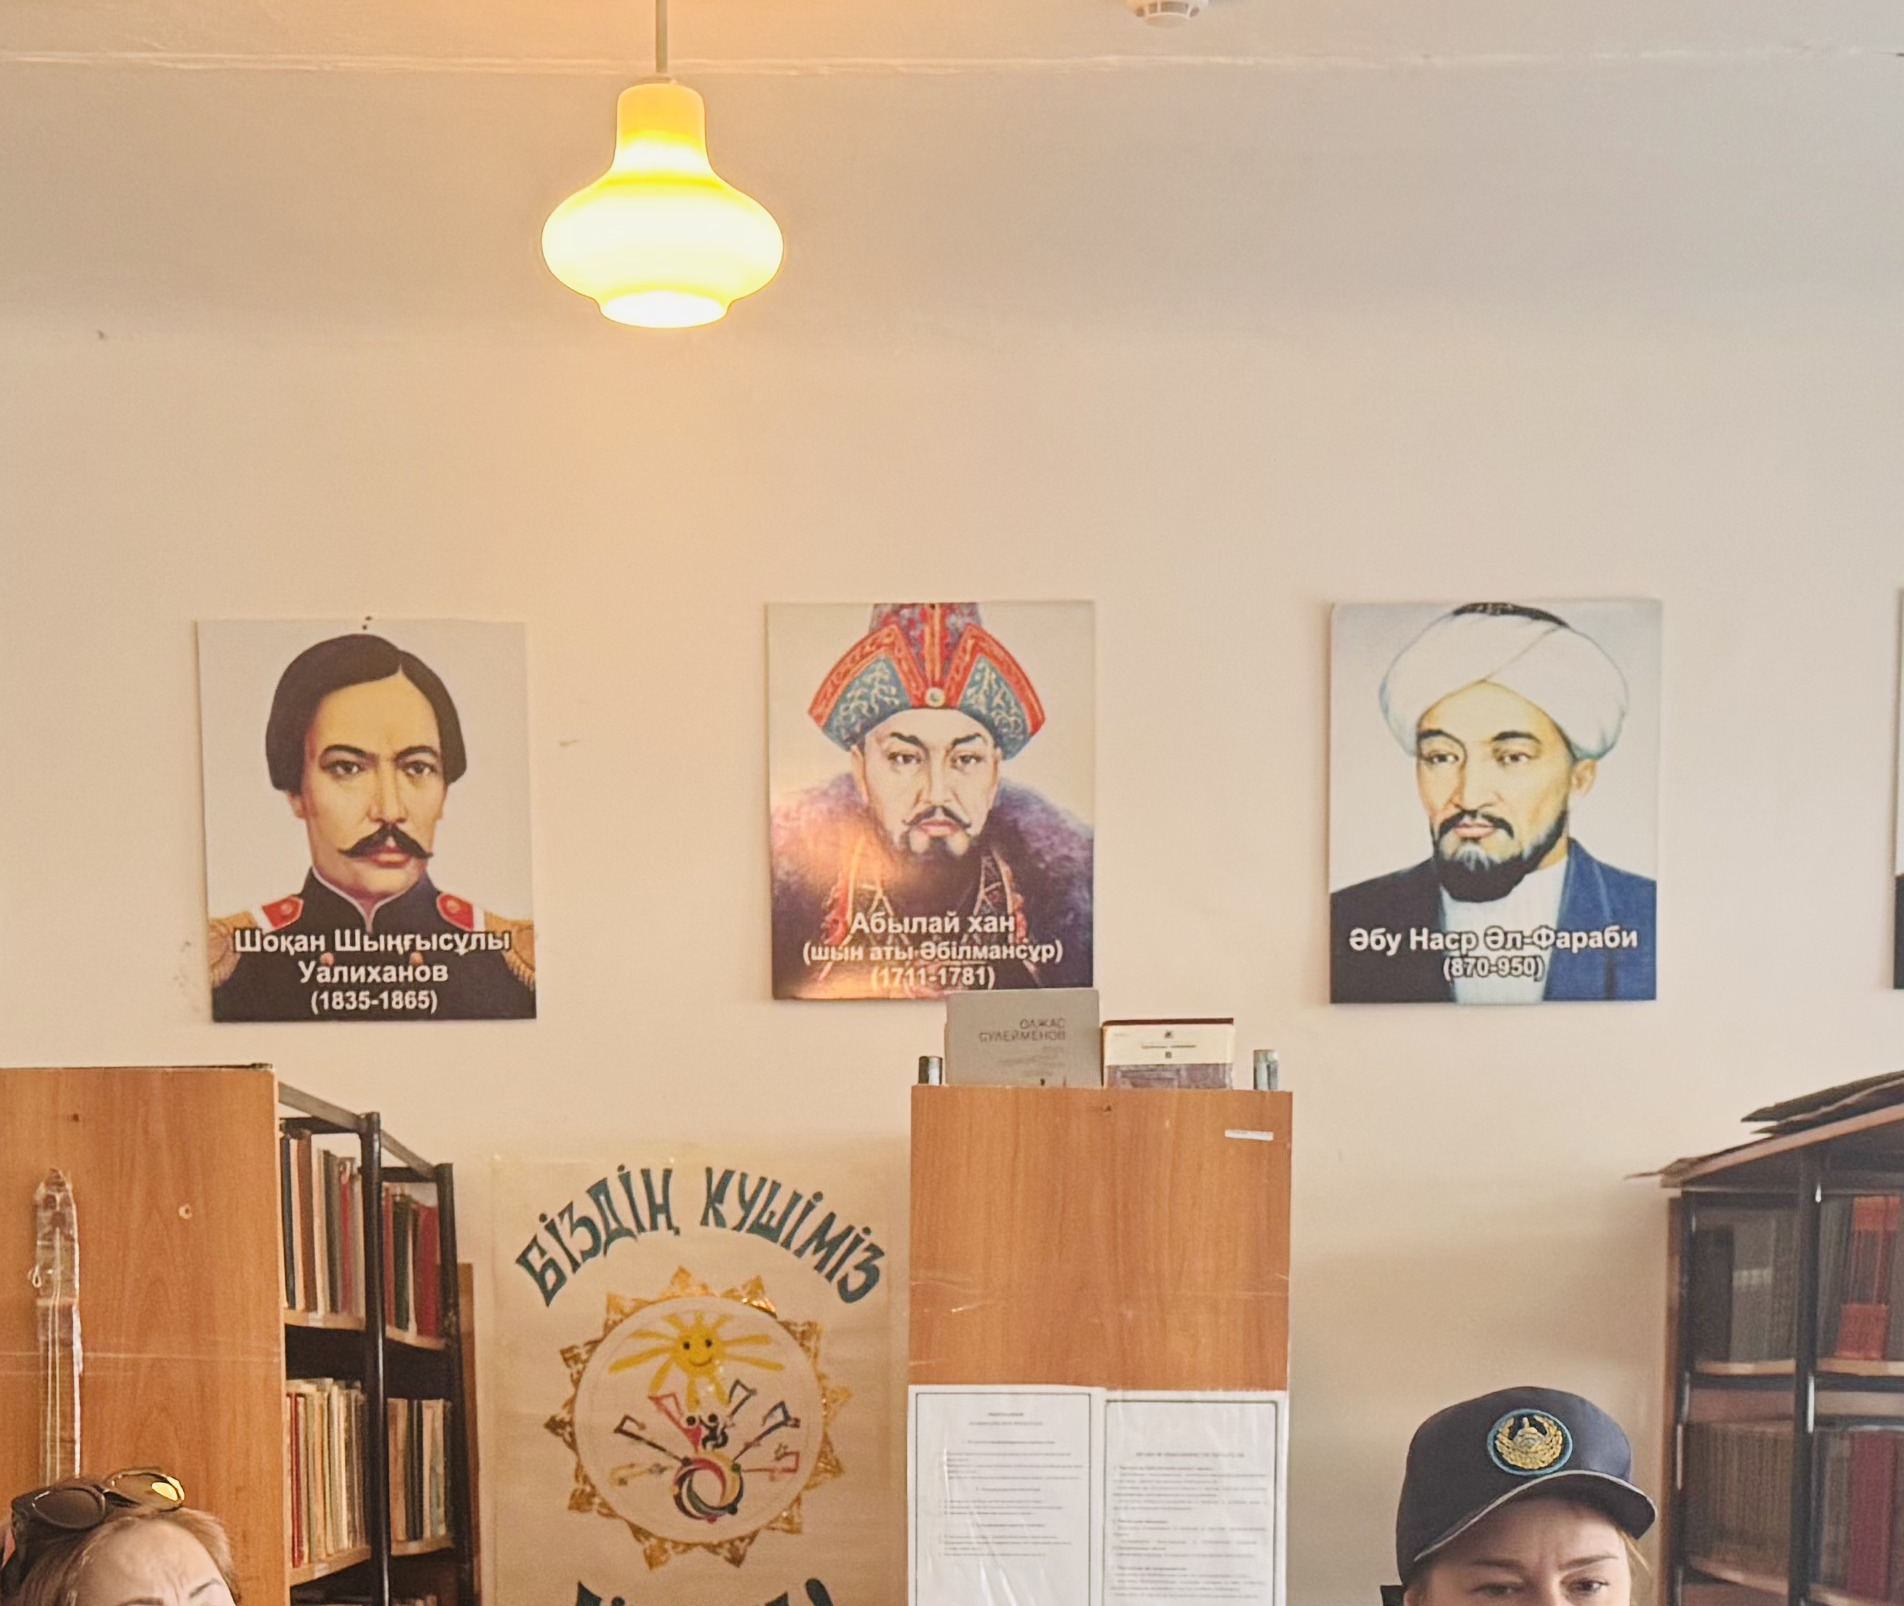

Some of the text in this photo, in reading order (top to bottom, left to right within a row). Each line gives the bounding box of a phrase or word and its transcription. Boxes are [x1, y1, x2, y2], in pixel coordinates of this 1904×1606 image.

[850, 911, 1015, 934] Абылай хан
[234, 929, 510, 956] Шоқан Шыңғысұлы
[1349, 925, 1638, 956] Әбу Наср Әл-Фараби
[802, 942, 863, 965] (шын
[870, 944, 913, 961] аты
[298, 961, 449, 984] Уалиханов
[870, 965, 996, 990] (1711-1781)
[1443, 957, 1545, 981] (870-950)
[310, 989, 438, 1015] (1835-1865)
